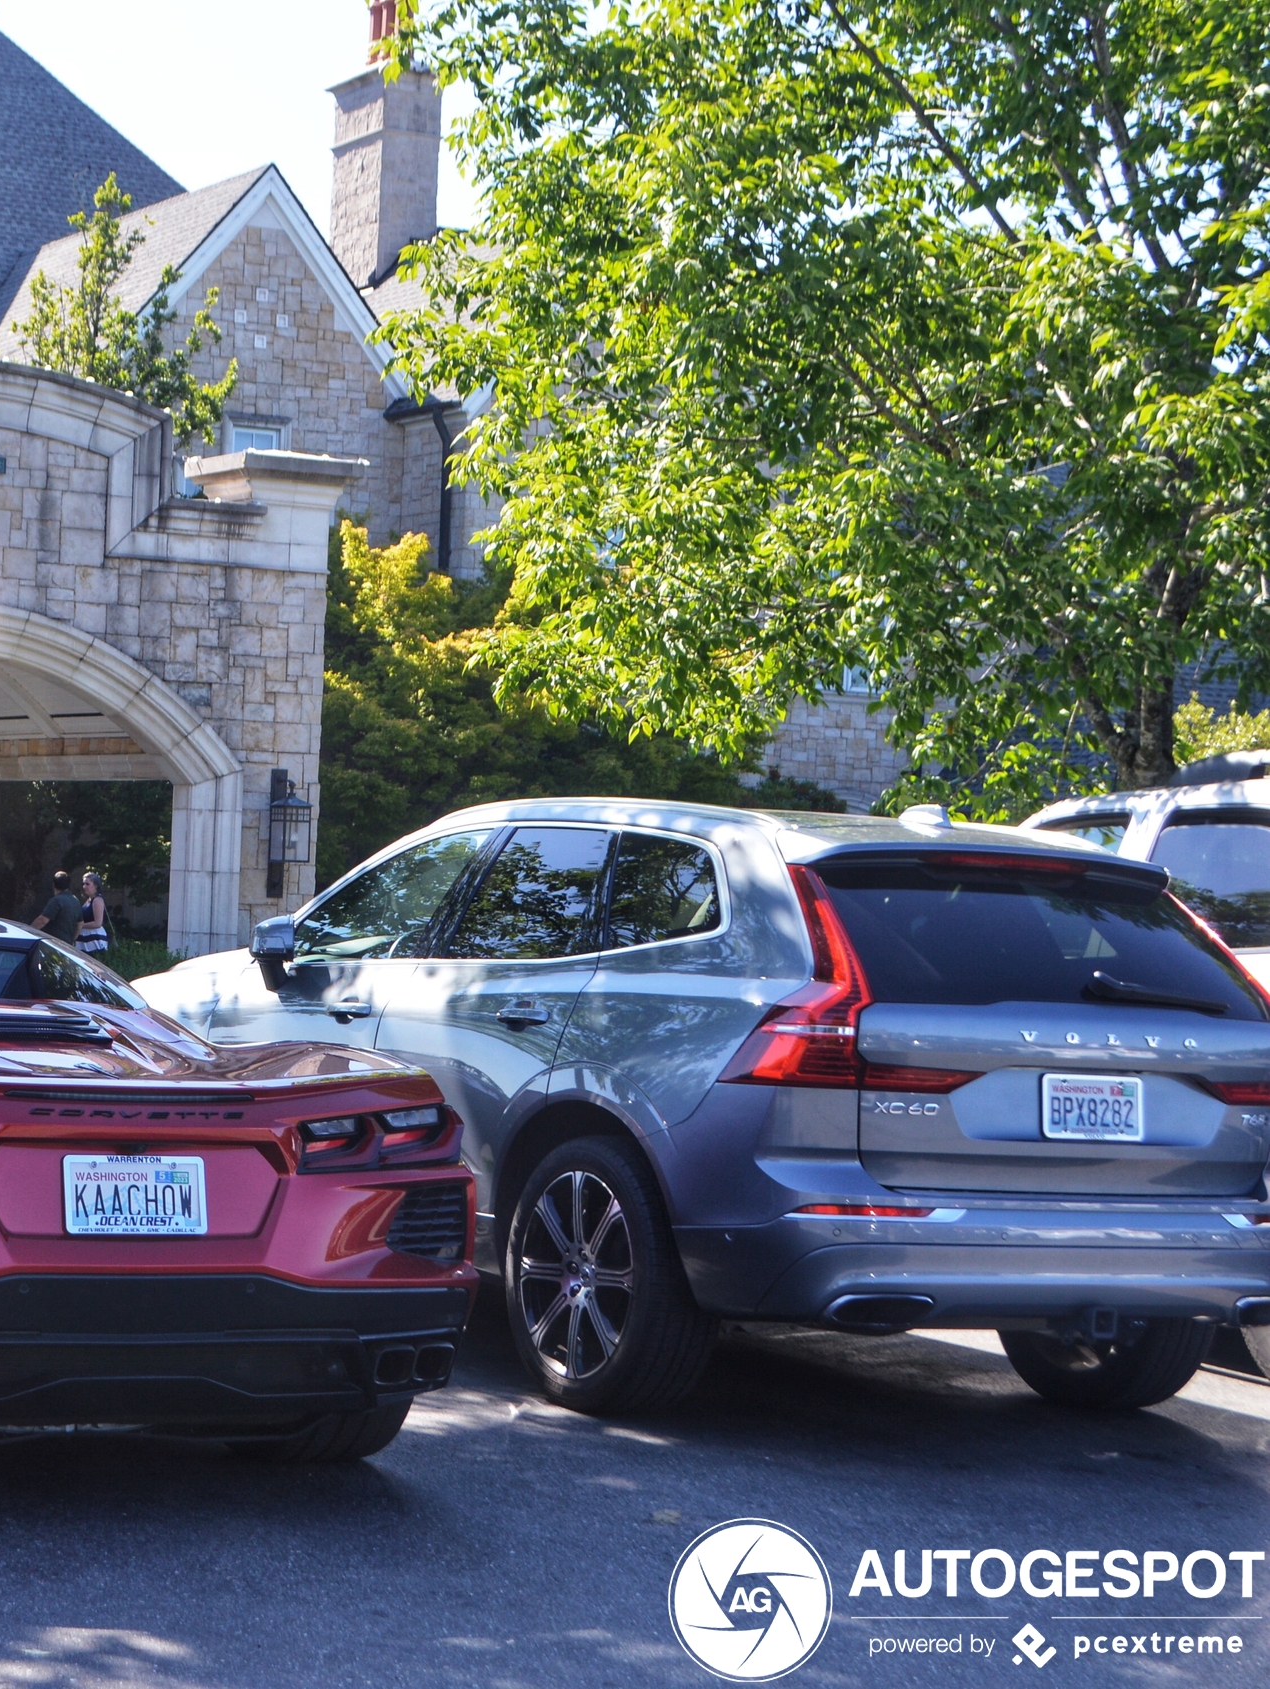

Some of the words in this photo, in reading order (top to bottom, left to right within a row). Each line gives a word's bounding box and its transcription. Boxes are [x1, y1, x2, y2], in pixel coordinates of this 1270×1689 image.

[1021, 1030, 1197, 1050] VOLVO
[1052, 1085, 1104, 1094] WASHINGTON
[29, 1107, 244, 1119] CORVETTE
[1051, 1097, 1134, 1128] BPX8282
[75, 1172, 148, 1181] WASHINGTON
[159, 1172, 165, 1180] 5
[75, 1184, 192, 1218] KAACHOW
[100, 1216, 138, 1226] OCEAN
[140, 1216, 174, 1226] CREST
